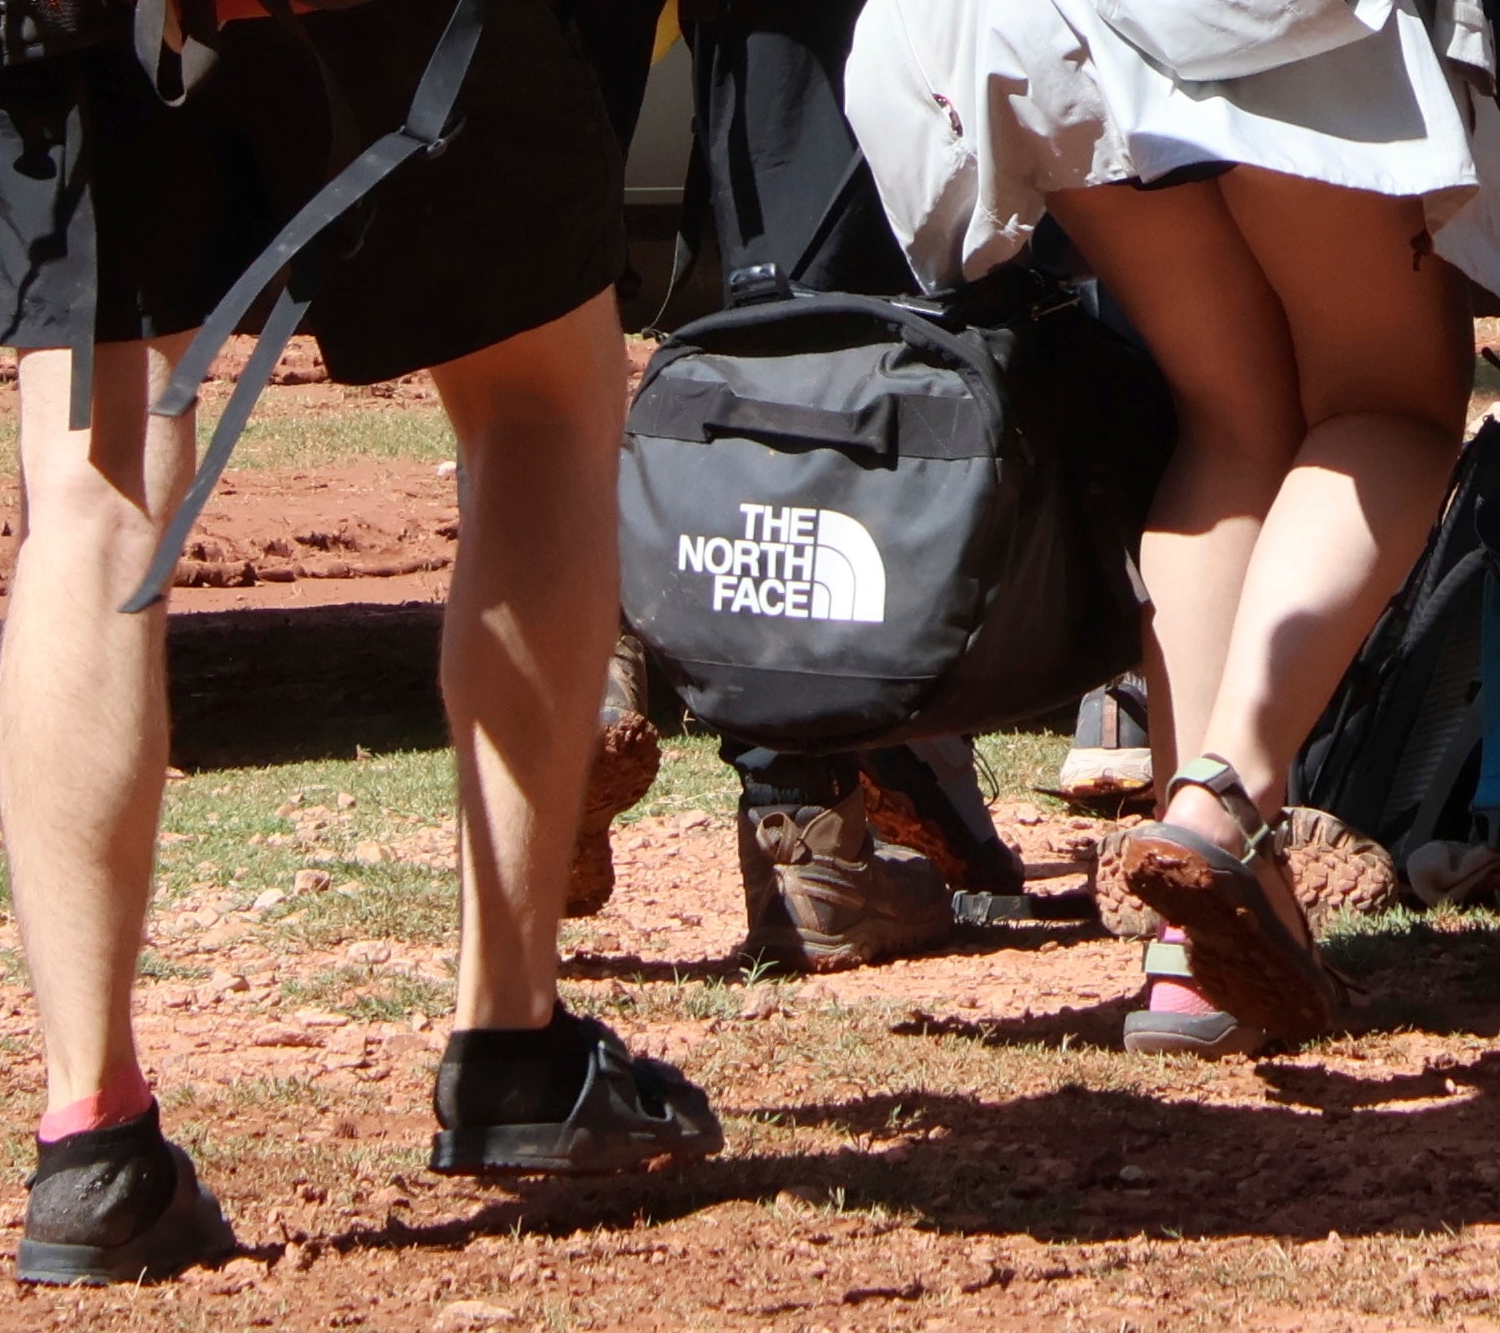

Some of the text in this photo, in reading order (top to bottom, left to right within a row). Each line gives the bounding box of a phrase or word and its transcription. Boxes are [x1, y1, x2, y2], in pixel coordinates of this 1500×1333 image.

[739, 502, 818, 544] THE
[677, 534, 815, 582] NORTH
[712, 574, 812, 619] FACE
